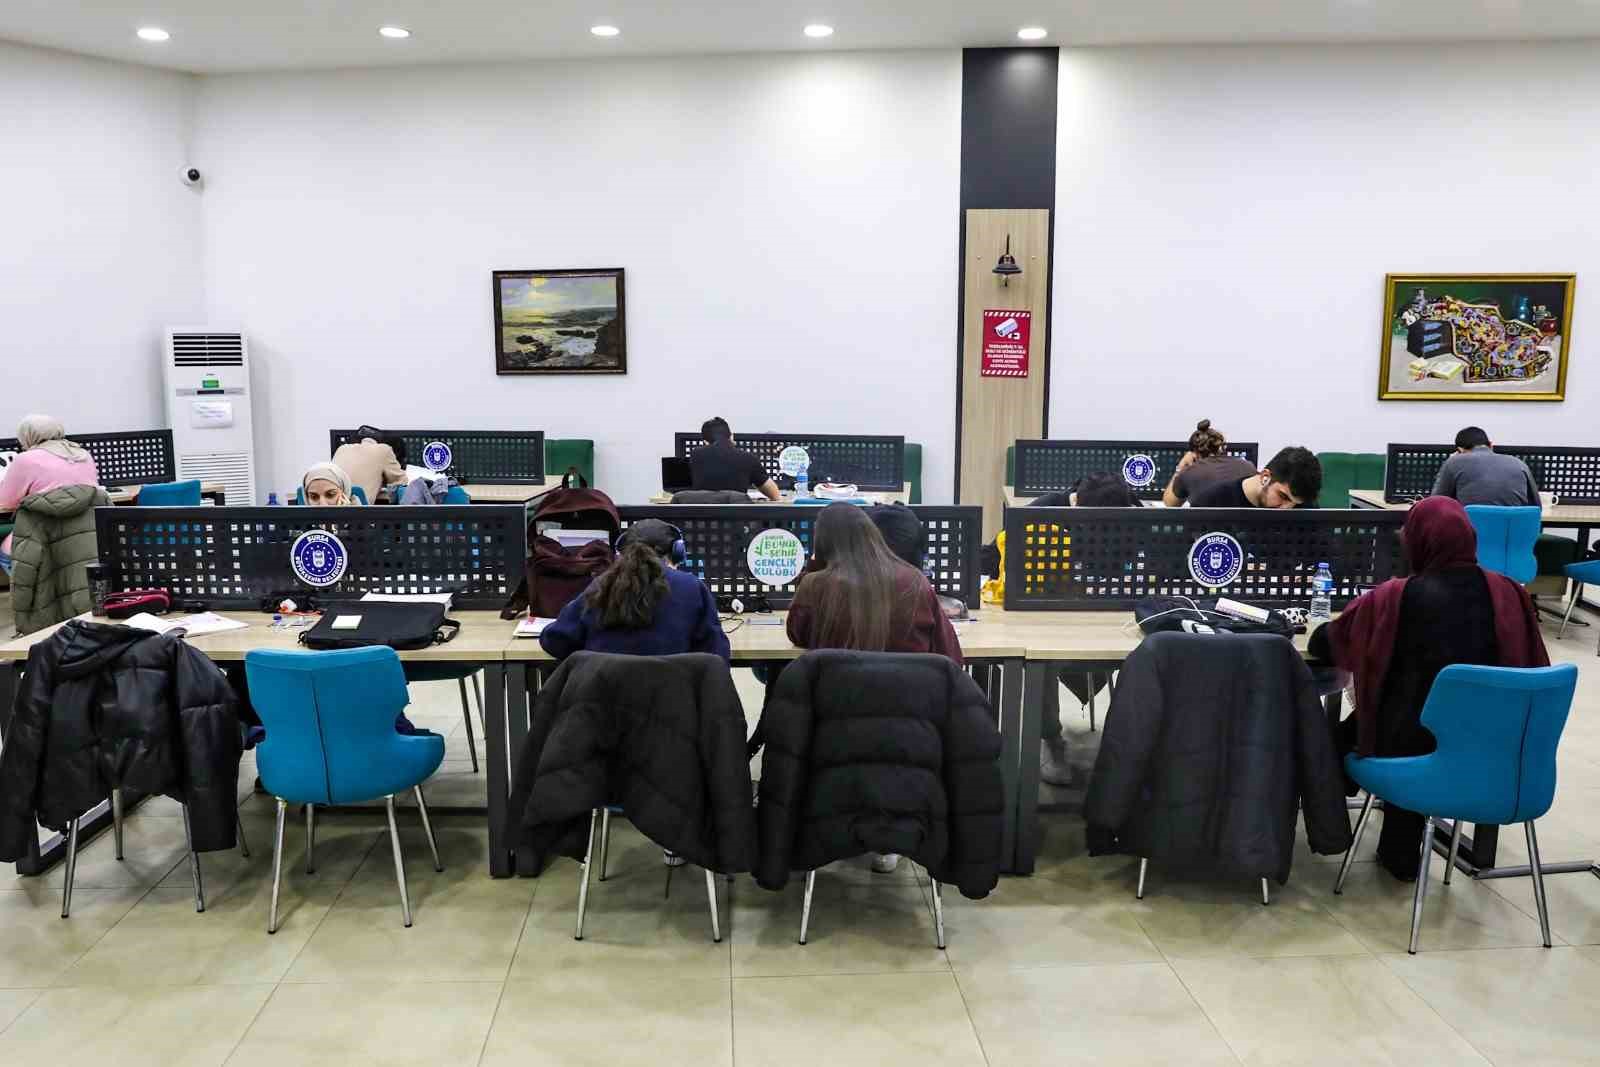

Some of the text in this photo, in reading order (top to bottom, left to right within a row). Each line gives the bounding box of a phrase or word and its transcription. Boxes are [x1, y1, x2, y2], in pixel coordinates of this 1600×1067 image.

[307, 534, 329, 543] BURSA
[1207, 536, 1228, 544] BURSA
[754, 558, 796, 568] GENÇLİK
